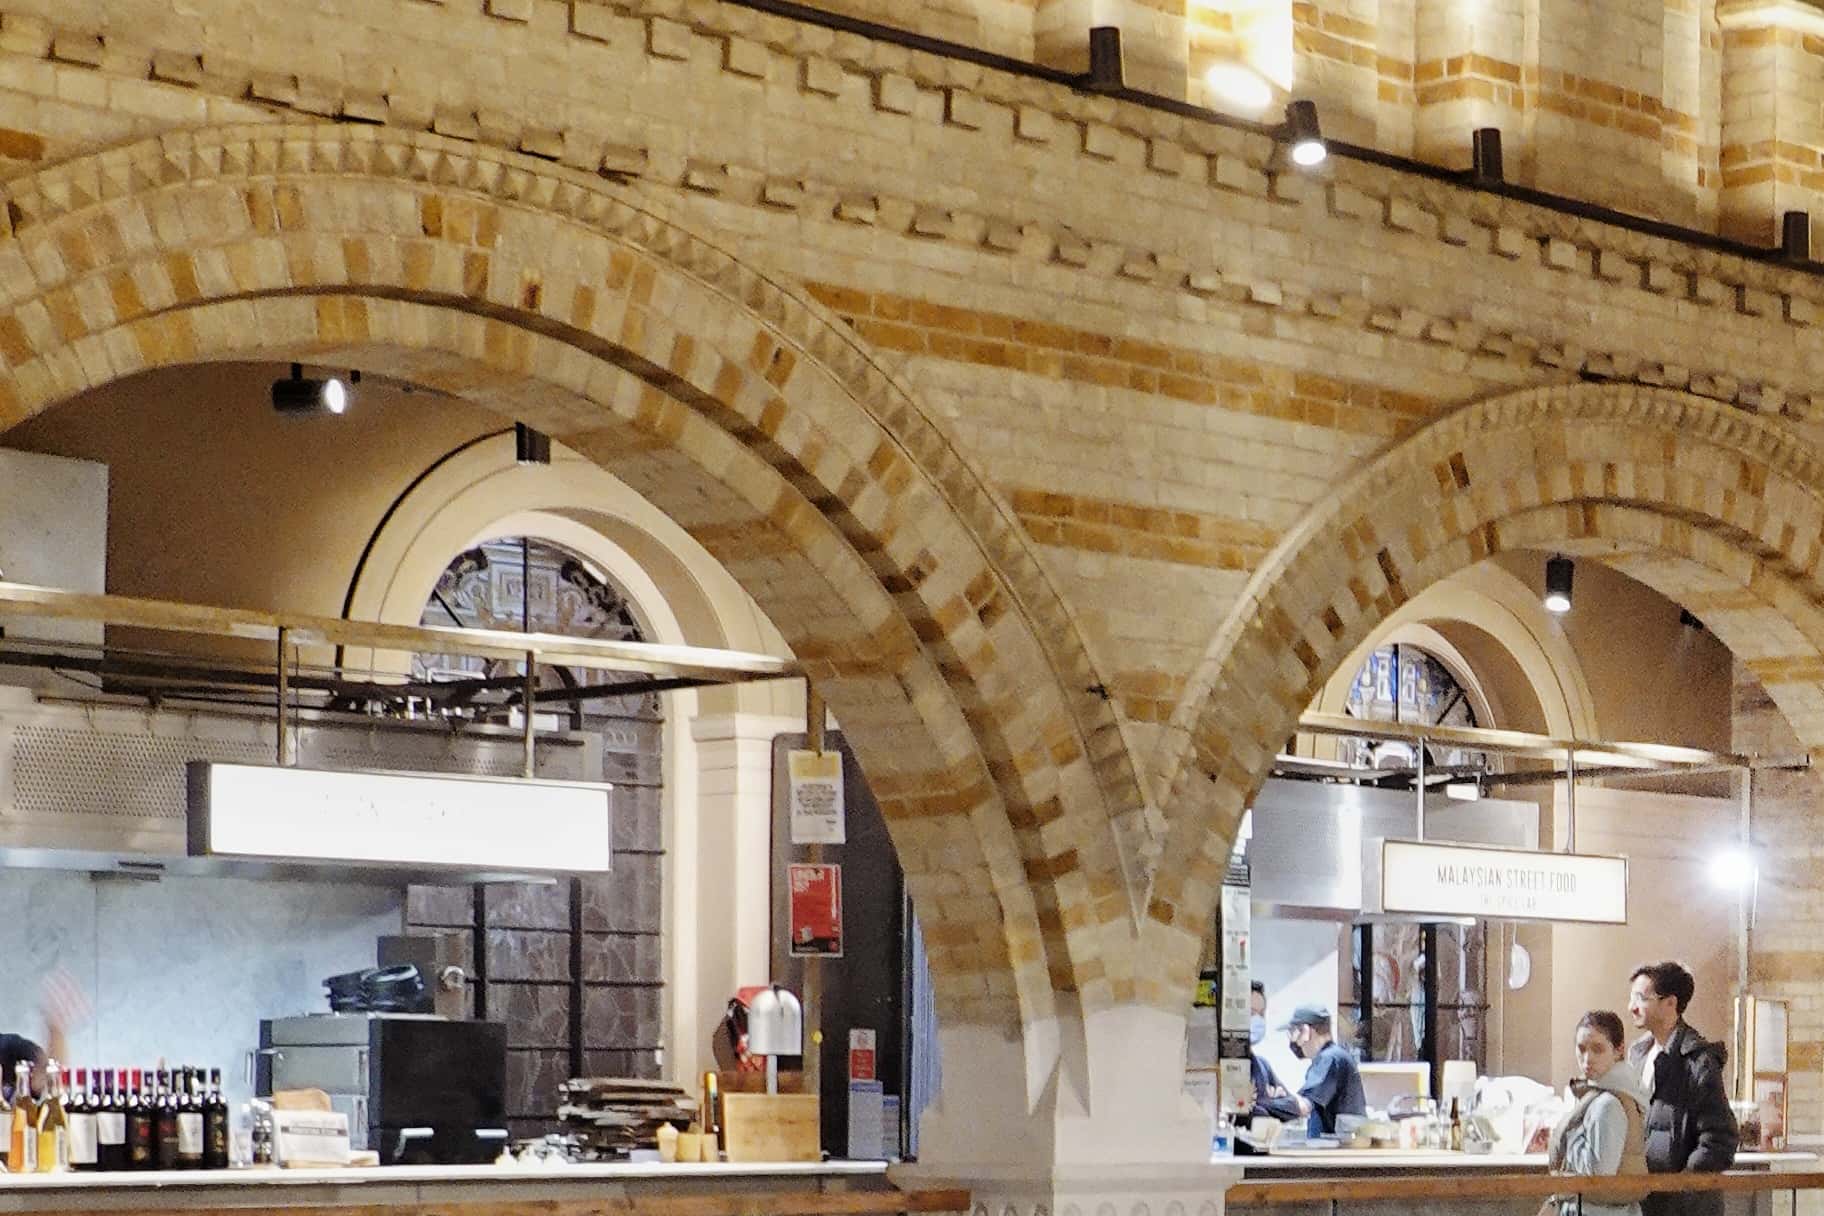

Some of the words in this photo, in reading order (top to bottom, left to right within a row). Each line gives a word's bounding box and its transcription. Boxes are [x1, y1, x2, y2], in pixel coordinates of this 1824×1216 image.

[1437, 864, 1502, 888] MALAYSIAN
[1506, 869, 1545, 890] STREET
[1550, 872, 1577, 893] FOOD
